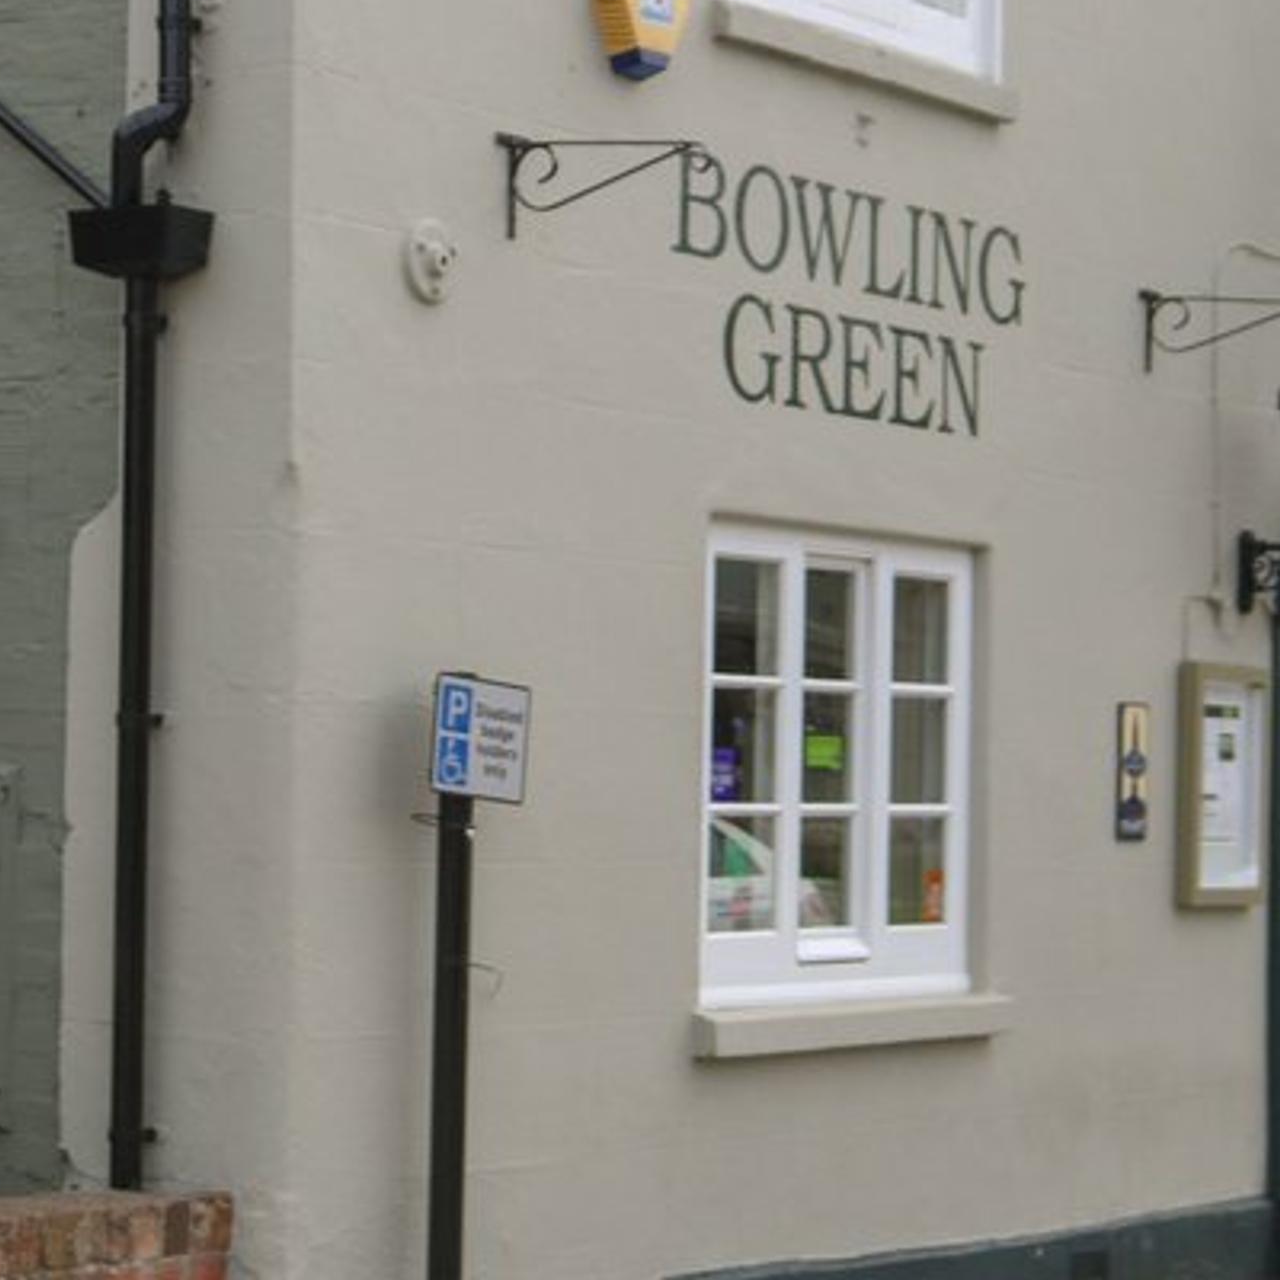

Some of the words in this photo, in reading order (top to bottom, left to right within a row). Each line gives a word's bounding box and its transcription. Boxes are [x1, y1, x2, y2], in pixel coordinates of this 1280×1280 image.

[671, 149, 1026, 327] BOWLING
[723, 293, 985, 438] GREEN
[446, 690, 468, 728] P
